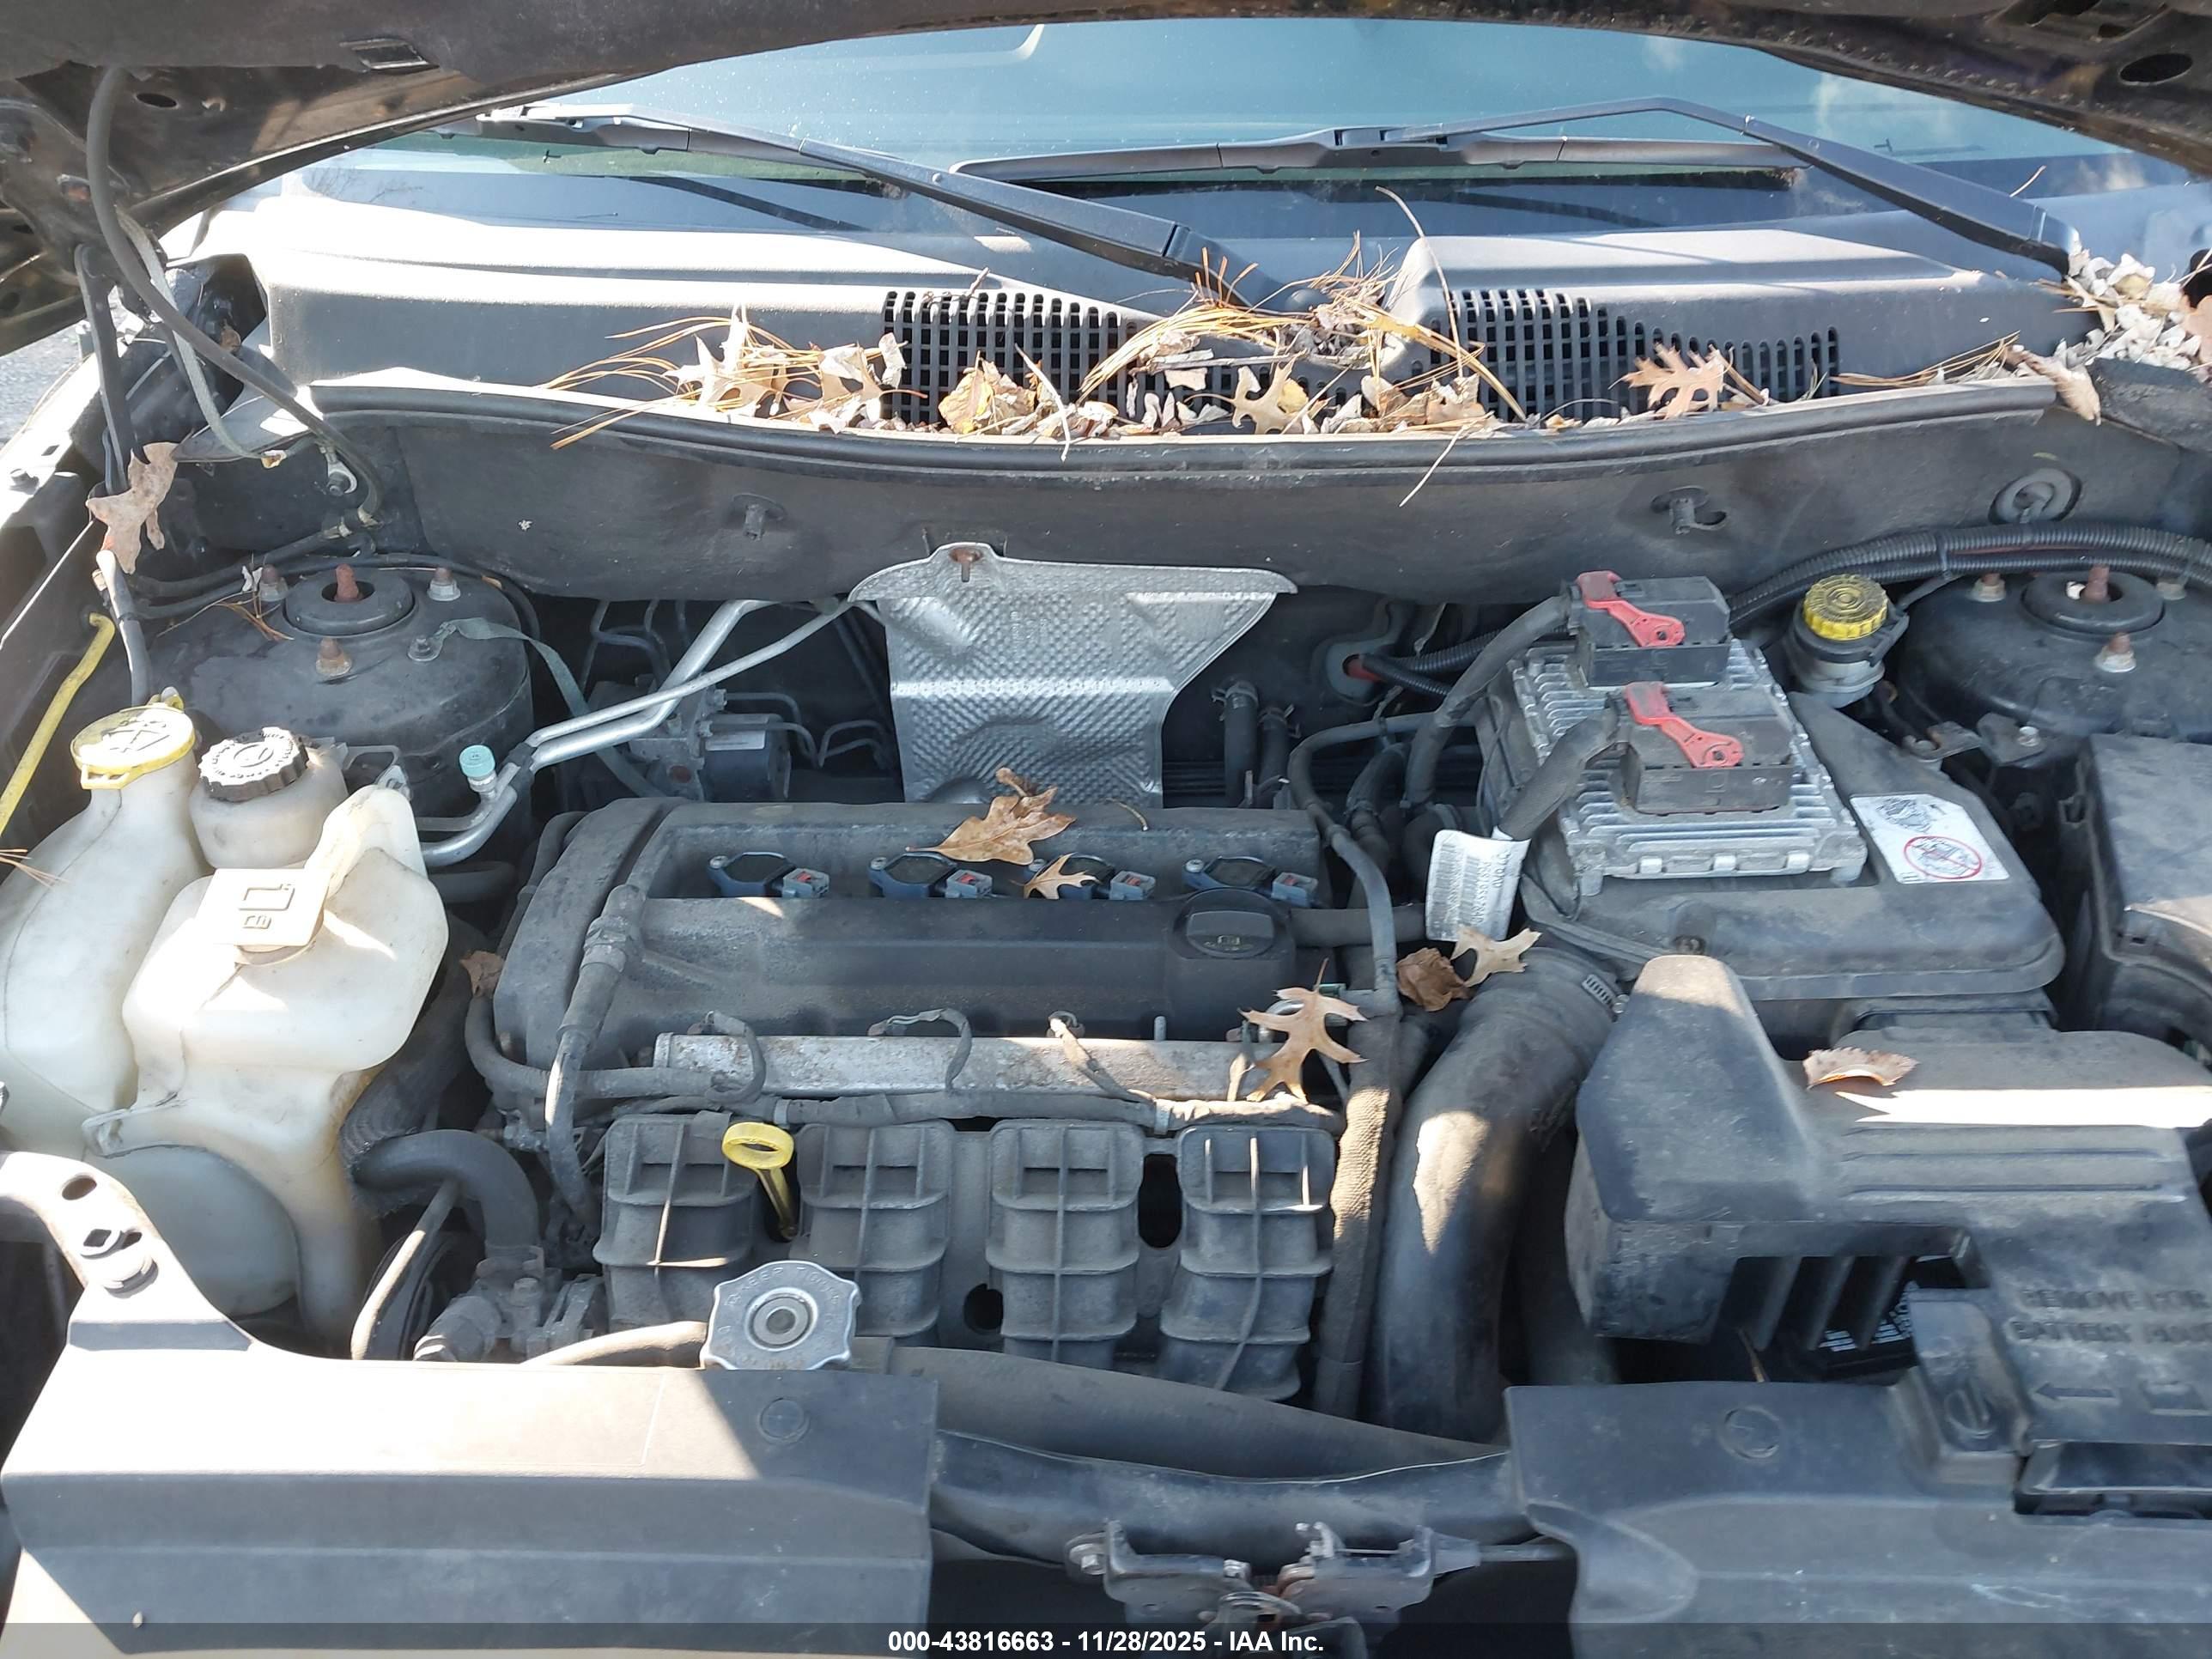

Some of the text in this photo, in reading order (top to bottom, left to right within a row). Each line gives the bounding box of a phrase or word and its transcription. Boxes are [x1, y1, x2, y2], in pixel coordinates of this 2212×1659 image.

[2021, 1290, 2211, 1311] REMOVE FOR
[2008, 1320, 2132, 1343] BATTERY
